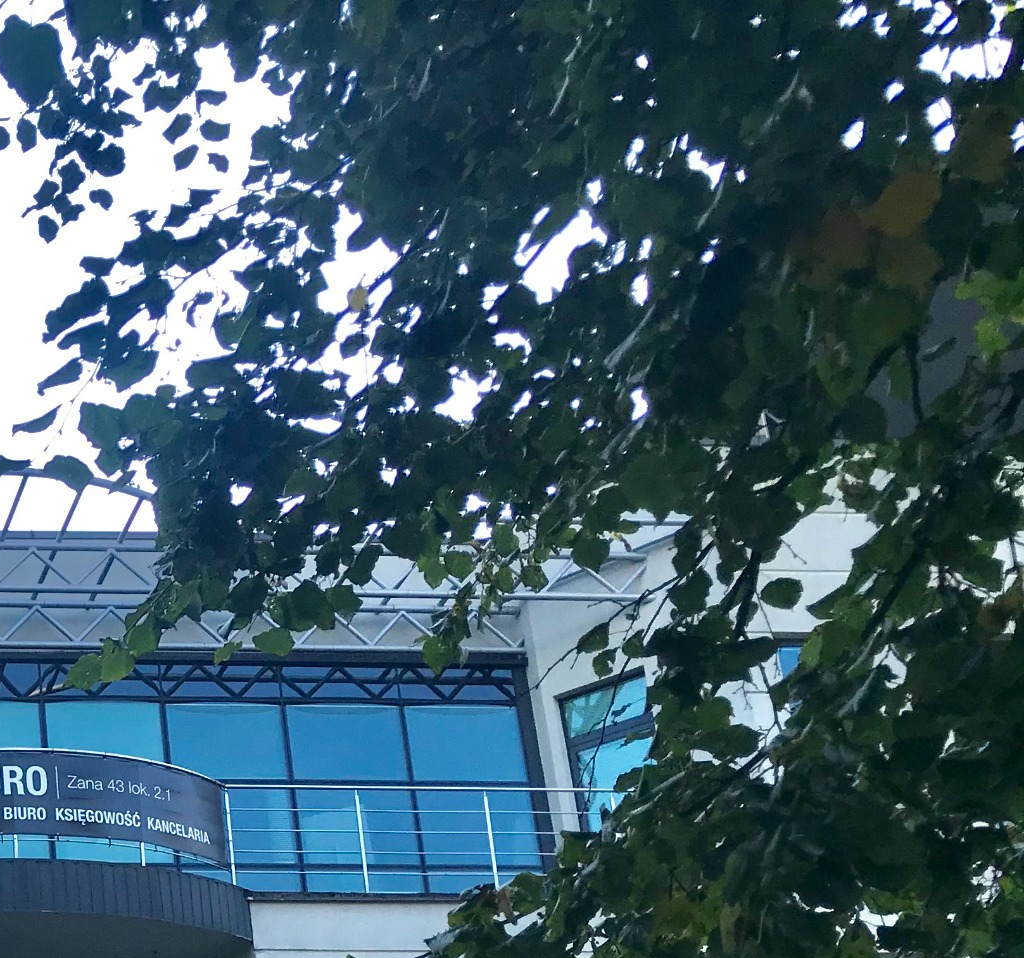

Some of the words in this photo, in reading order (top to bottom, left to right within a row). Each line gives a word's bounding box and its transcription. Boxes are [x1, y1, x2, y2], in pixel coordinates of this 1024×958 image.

[67, 775, 103, 791] Zana
[108, 779, 125, 793] 43
[128, 781, 151, 797] lok.
[154, 786, 171, 801] 2.1
[3, 807, 46, 820] BIURO
[55, 807, 141, 828] KSIĘGOWOŚĆ
[147, 816, 211, 845] KANCELARIA
